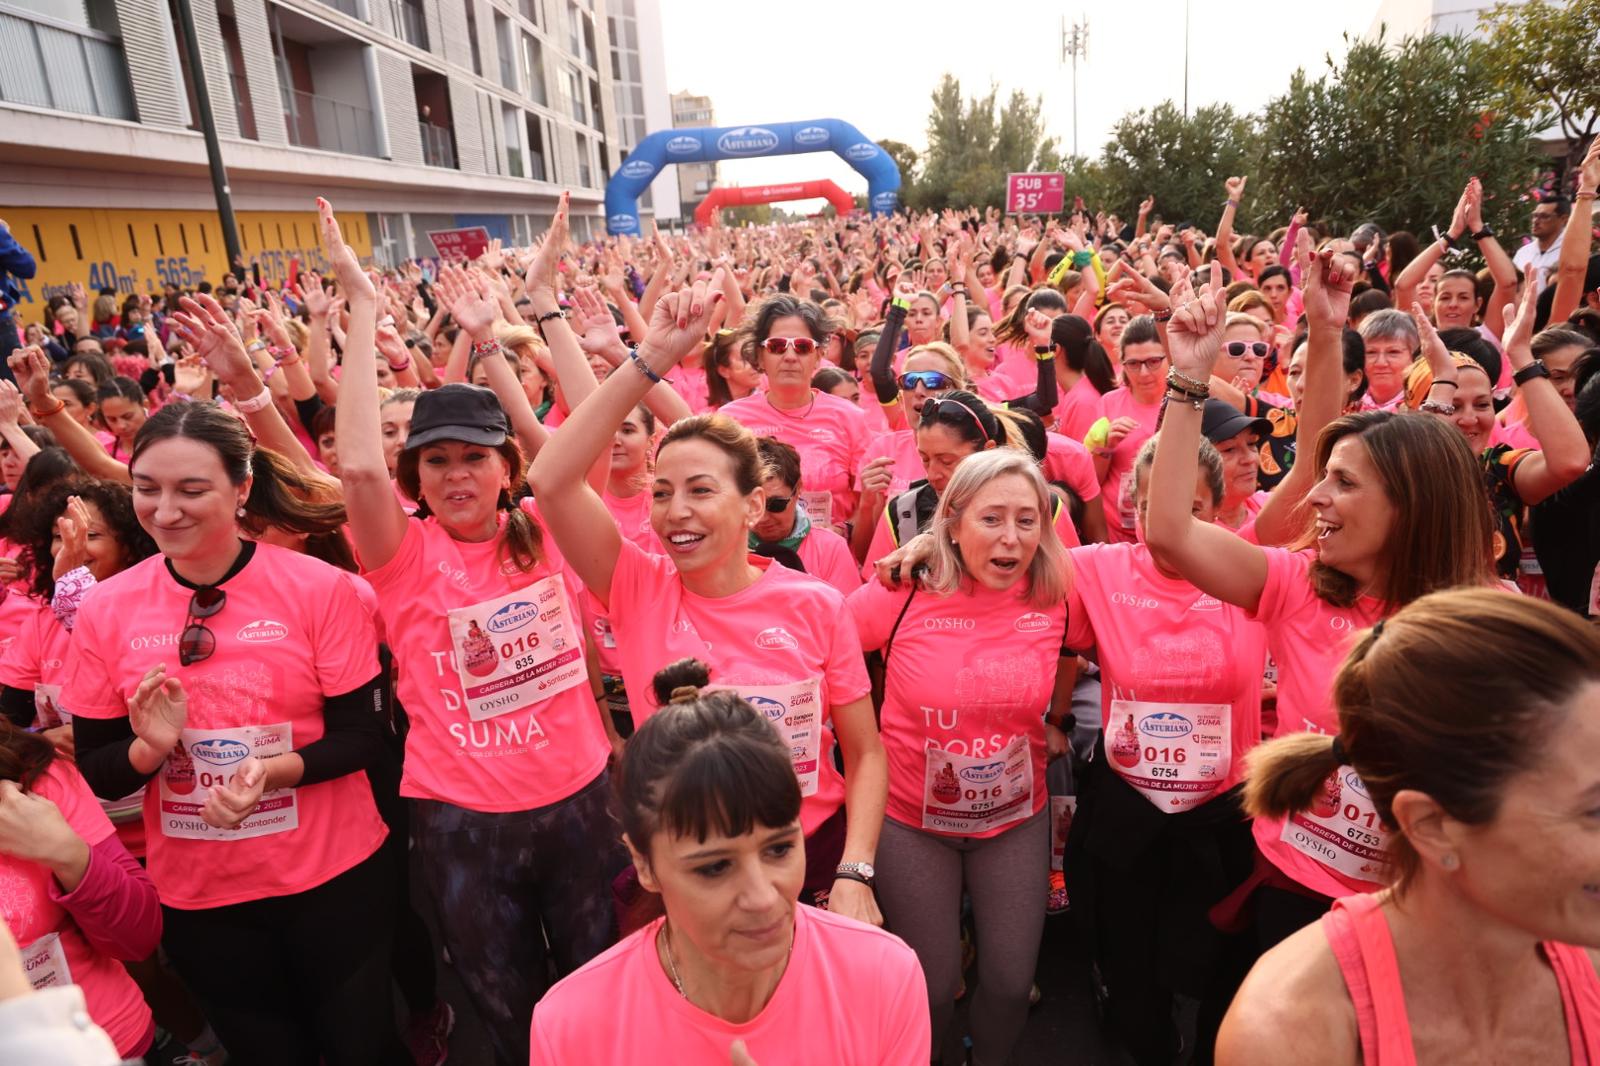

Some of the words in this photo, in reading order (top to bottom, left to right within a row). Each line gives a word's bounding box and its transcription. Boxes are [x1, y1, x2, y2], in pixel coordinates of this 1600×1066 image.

[1016, 178, 1042, 190] SUB
[433, 233, 462, 247] SUB
[1111, 591, 1159, 609] OYSHO
[492, 608, 536, 631] ASTURIANA
[924, 618, 976, 630] OYSHO
[240, 629, 286, 640] ASTURIANA
[500, 632, 541, 659] 016
[515, 654, 534, 670] 835
[480, 678, 514, 694] CARRERA
[516, 674, 526, 683] DE
[526, 670, 535, 679] LA
[536, 662, 557, 675] MUJER
[546, 667, 580, 688] Santander
[480, 693, 519, 712] OYSHO
[790, 696, 813, 707] SUMA
[920, 706, 958, 730] TU
[448, 714, 545, 748] SUMA
[1141, 721, 1189, 733] ASTURIANA
[254, 736, 281, 747] SUMA
[196, 747, 245, 760] ASTURIANA
[1144, 746, 1186, 763] 016
[964, 765, 1004, 780] ASTURIANA
[1152, 767, 1179, 779] 6754
[964, 785, 1002, 801] 016
[971, 801, 995, 811] 6751
[169, 819, 209, 832] OYSHO
[242, 815, 287, 830] Santander
[933, 818, 969, 829] OYSHO
[1303, 820, 1341, 844] CARRERA
[1341, 839, 1354, 850] DE
[1355, 845, 1367, 856] LA
[1346, 827, 1380, 847] 6753
[1295, 831, 1337, 861] OYSHO
